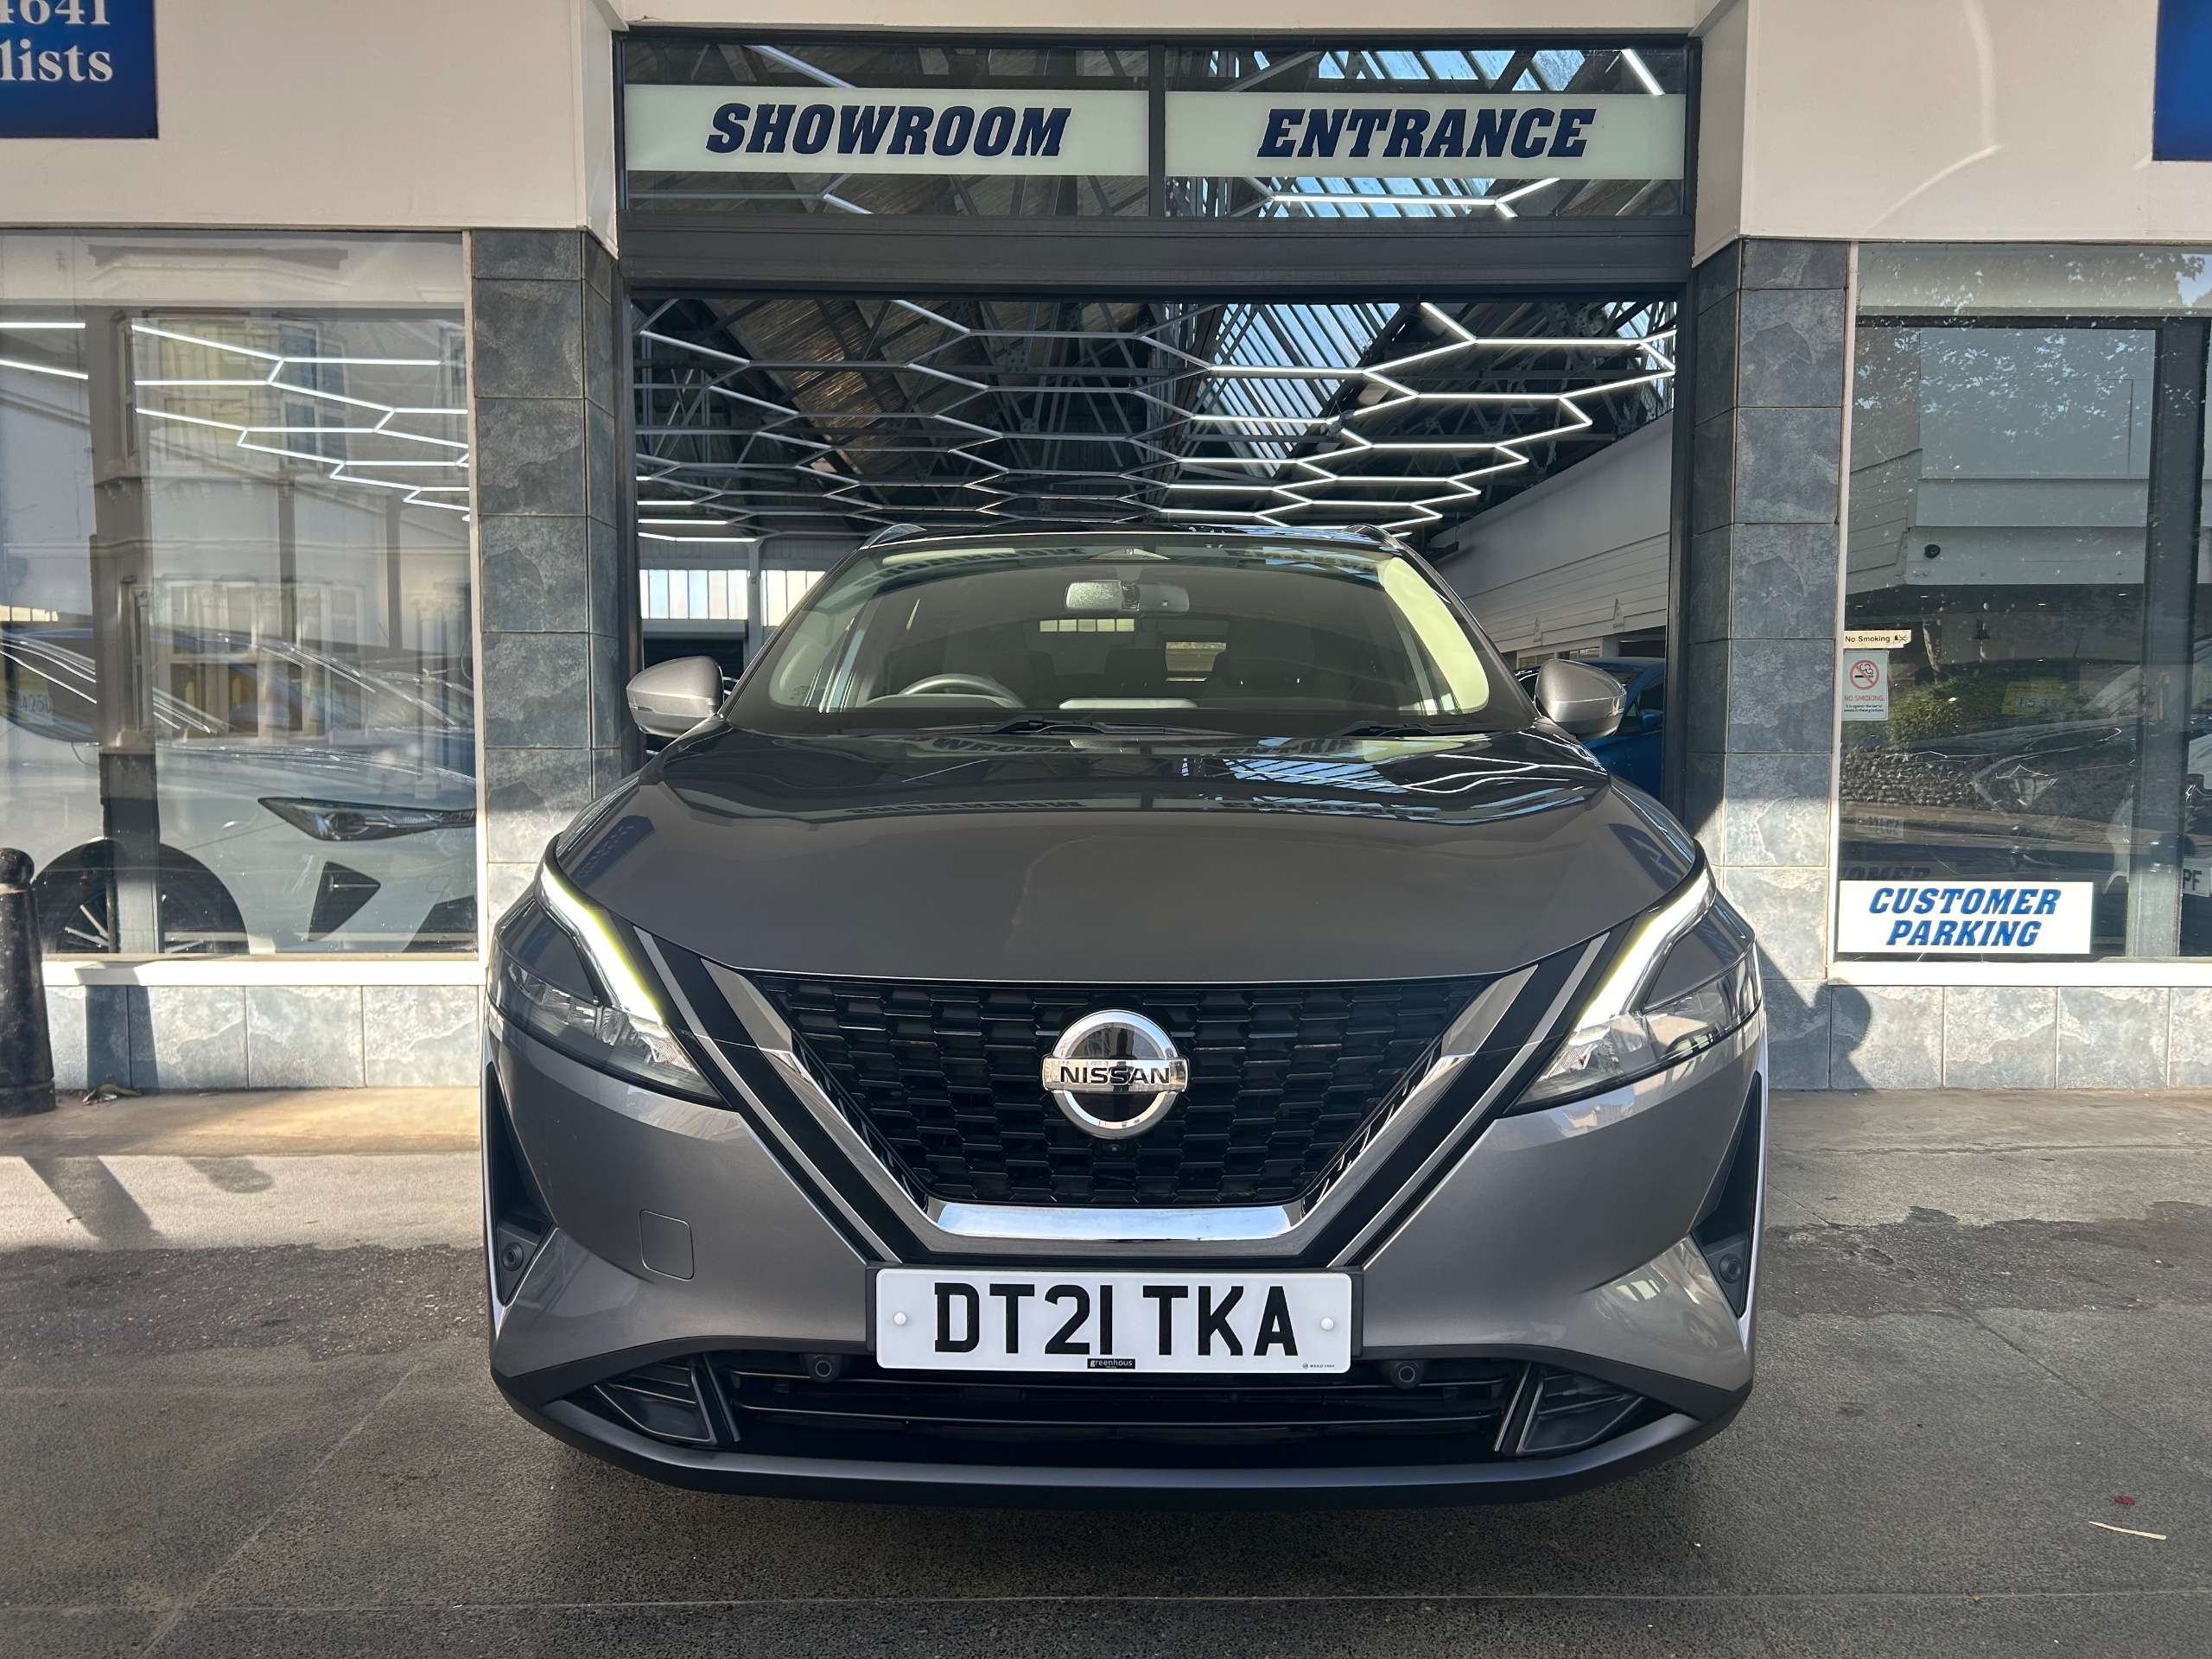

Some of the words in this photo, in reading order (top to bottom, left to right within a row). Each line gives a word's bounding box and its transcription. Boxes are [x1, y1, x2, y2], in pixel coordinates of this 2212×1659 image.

[0, 38, 113, 82] lists
[706, 103, 1072, 156] SHOWROOM
[1257, 108, 1597, 158] ENTRANCE
[1858, 635, 1891, 644] Smoking
[1869, 887, 2062, 914] CUSTOMER
[1886, 920, 2042, 946] PARKING
[1060, 1066, 1170, 1084] NISSAN
[934, 1282, 1113, 1356] DT21
[1142, 1286, 1299, 1357] TKA
[1090, 1359, 1133, 1368] greenhous
